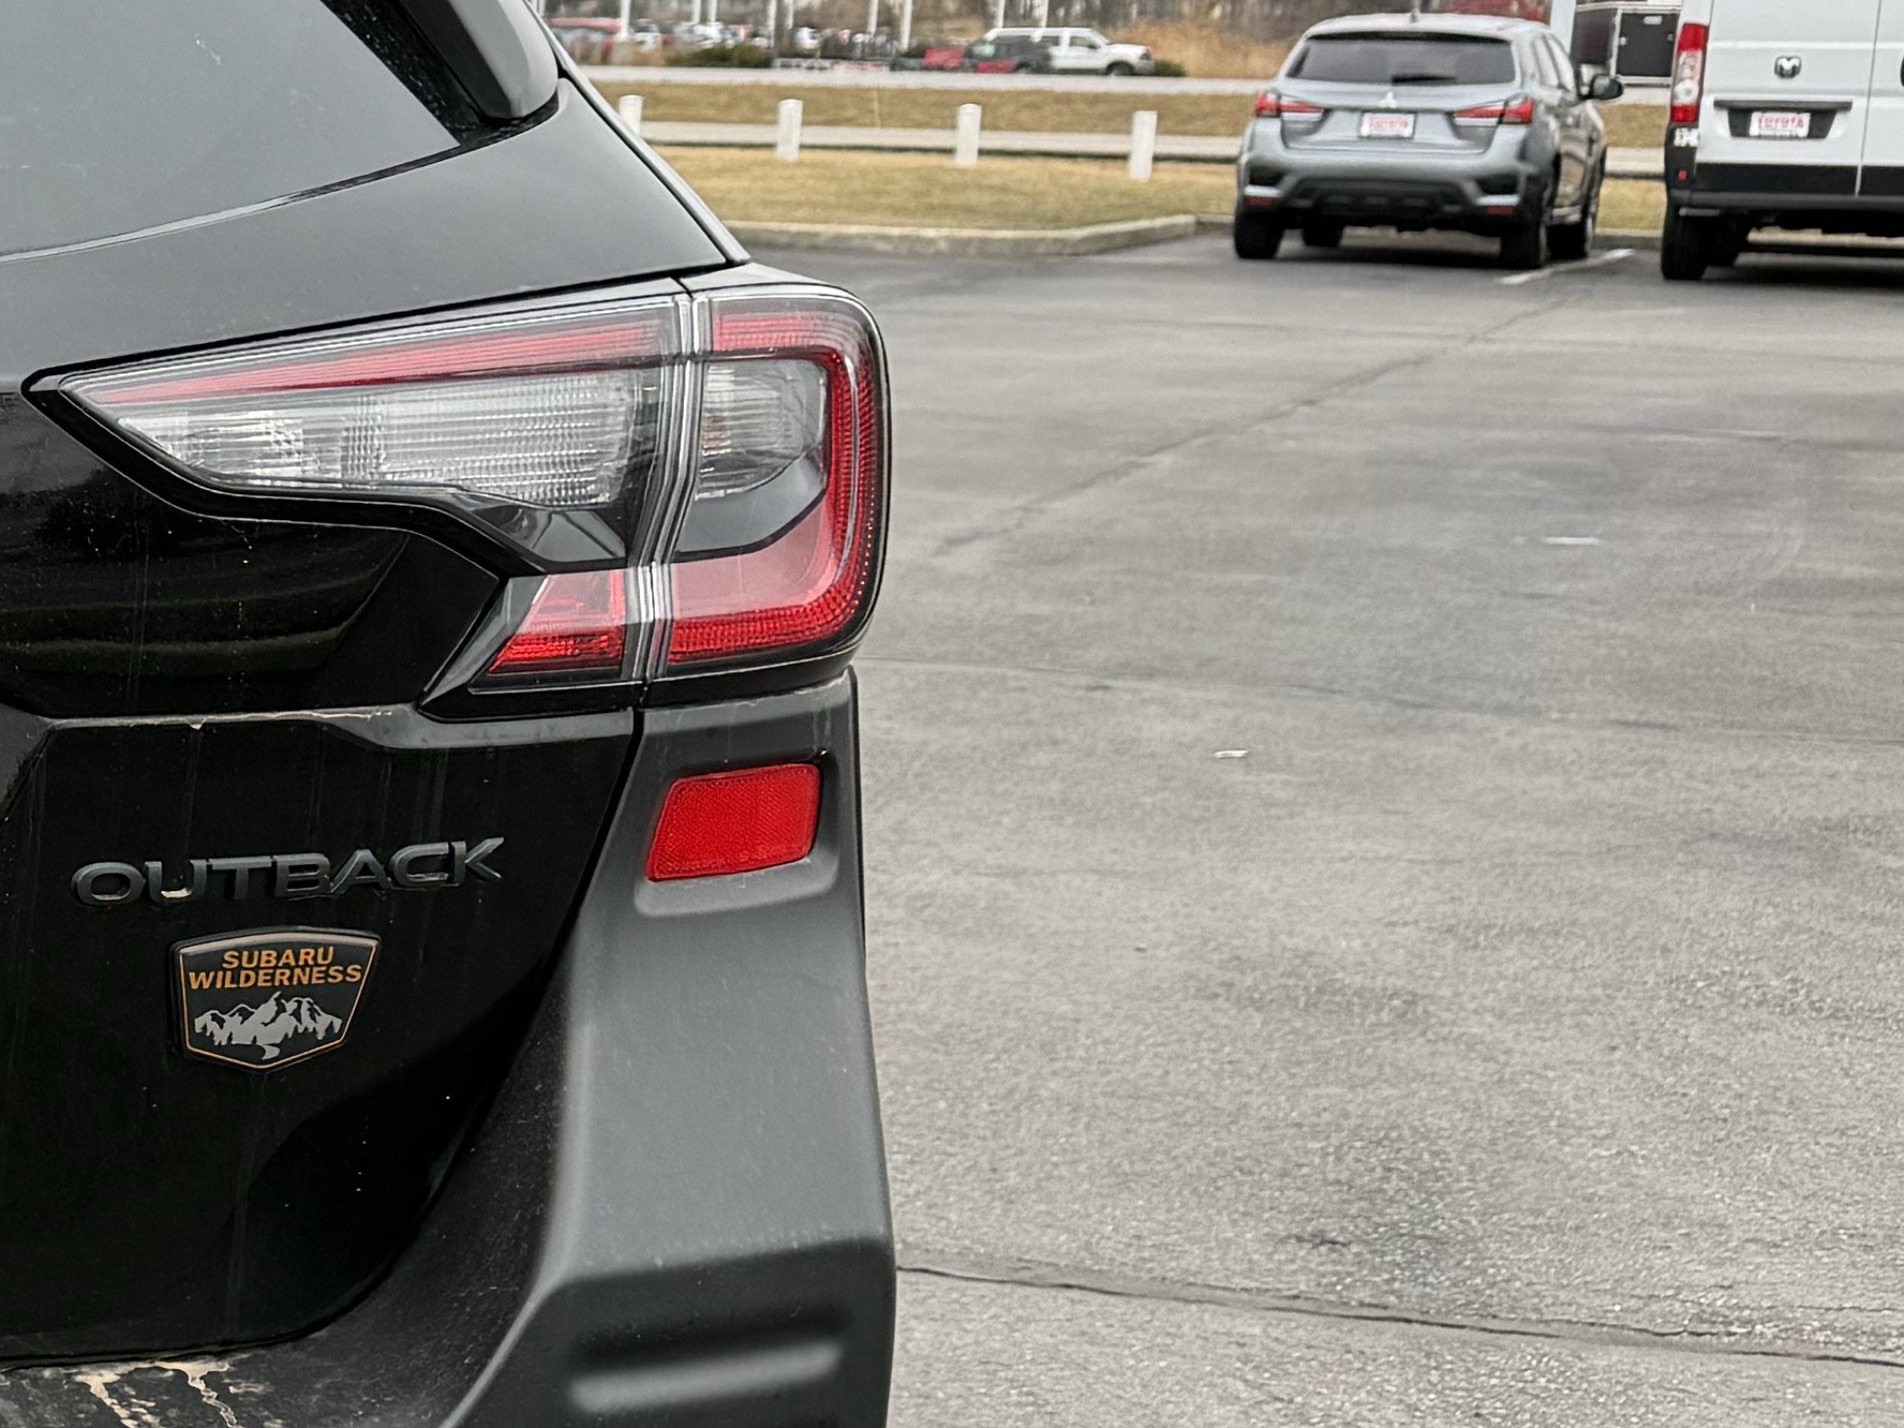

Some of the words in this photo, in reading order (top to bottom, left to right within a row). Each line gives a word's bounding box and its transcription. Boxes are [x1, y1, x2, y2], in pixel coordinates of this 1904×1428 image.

[72, 837, 505, 907] OUTBACK
[221, 945, 336, 970] SUBARU
[188, 964, 363, 990] WILDERNESS
